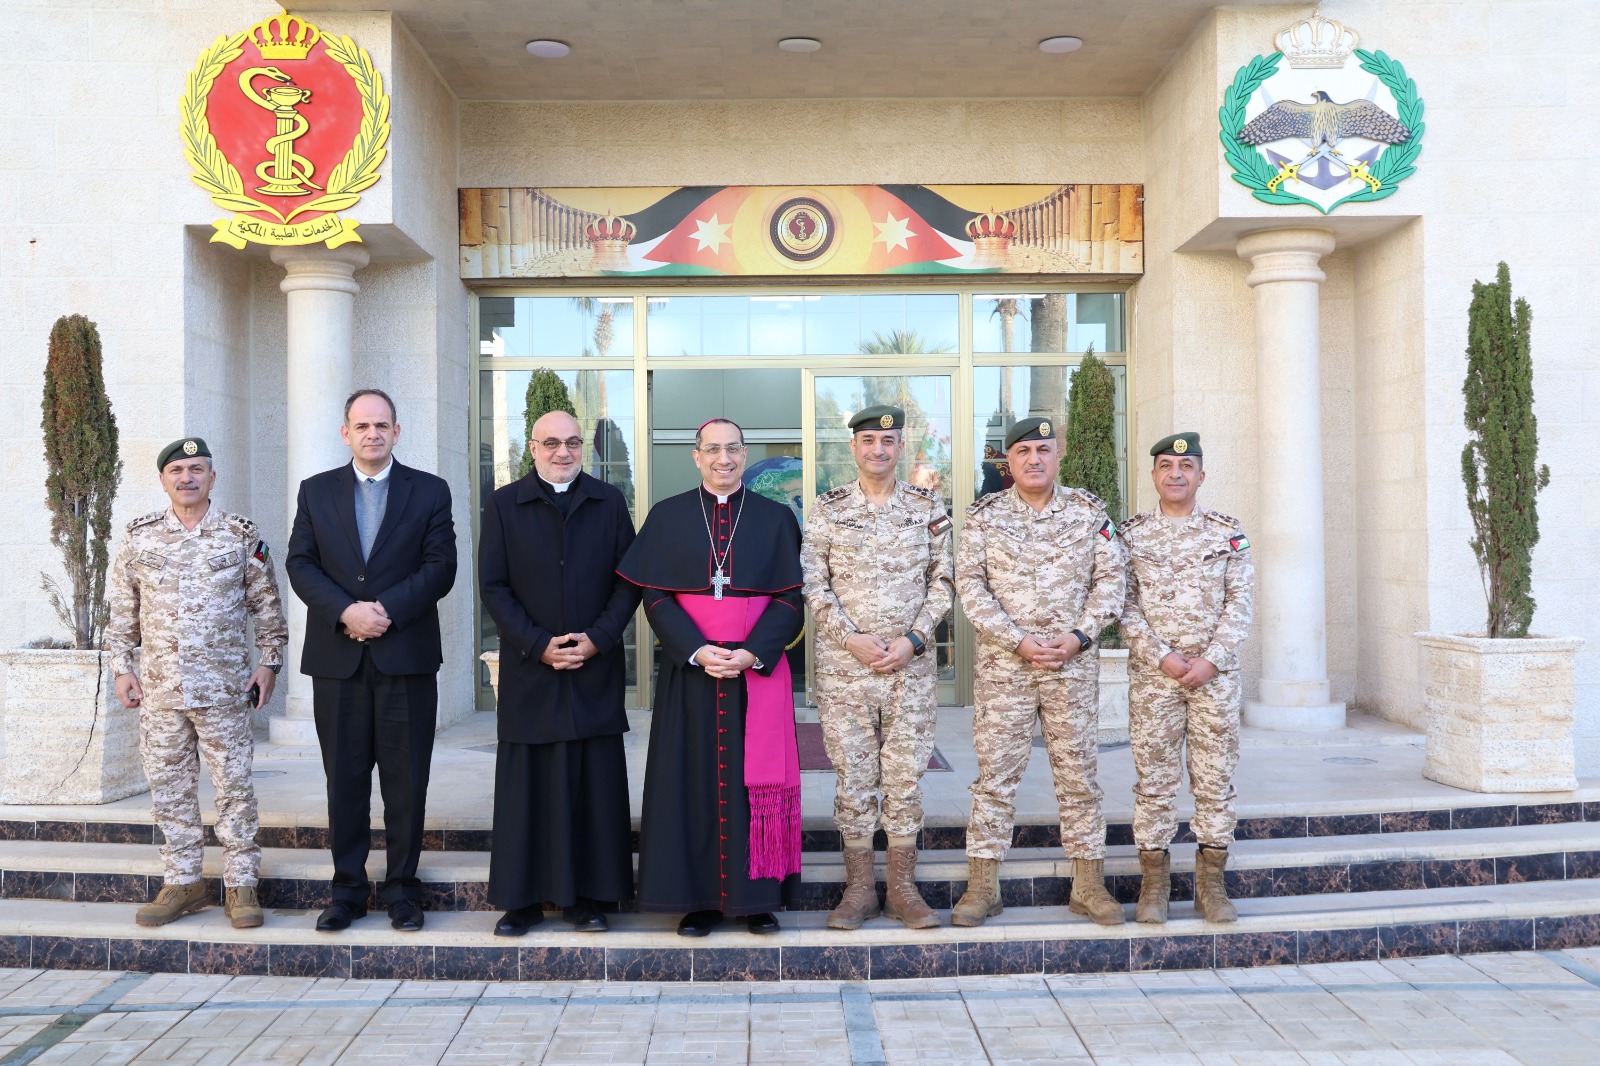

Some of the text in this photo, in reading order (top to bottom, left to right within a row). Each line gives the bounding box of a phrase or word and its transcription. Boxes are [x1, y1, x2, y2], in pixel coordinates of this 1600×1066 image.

[237, 217, 338, 241] الخدمات الطبية الملكية
[898, 518, 924, 530] JORDAN
